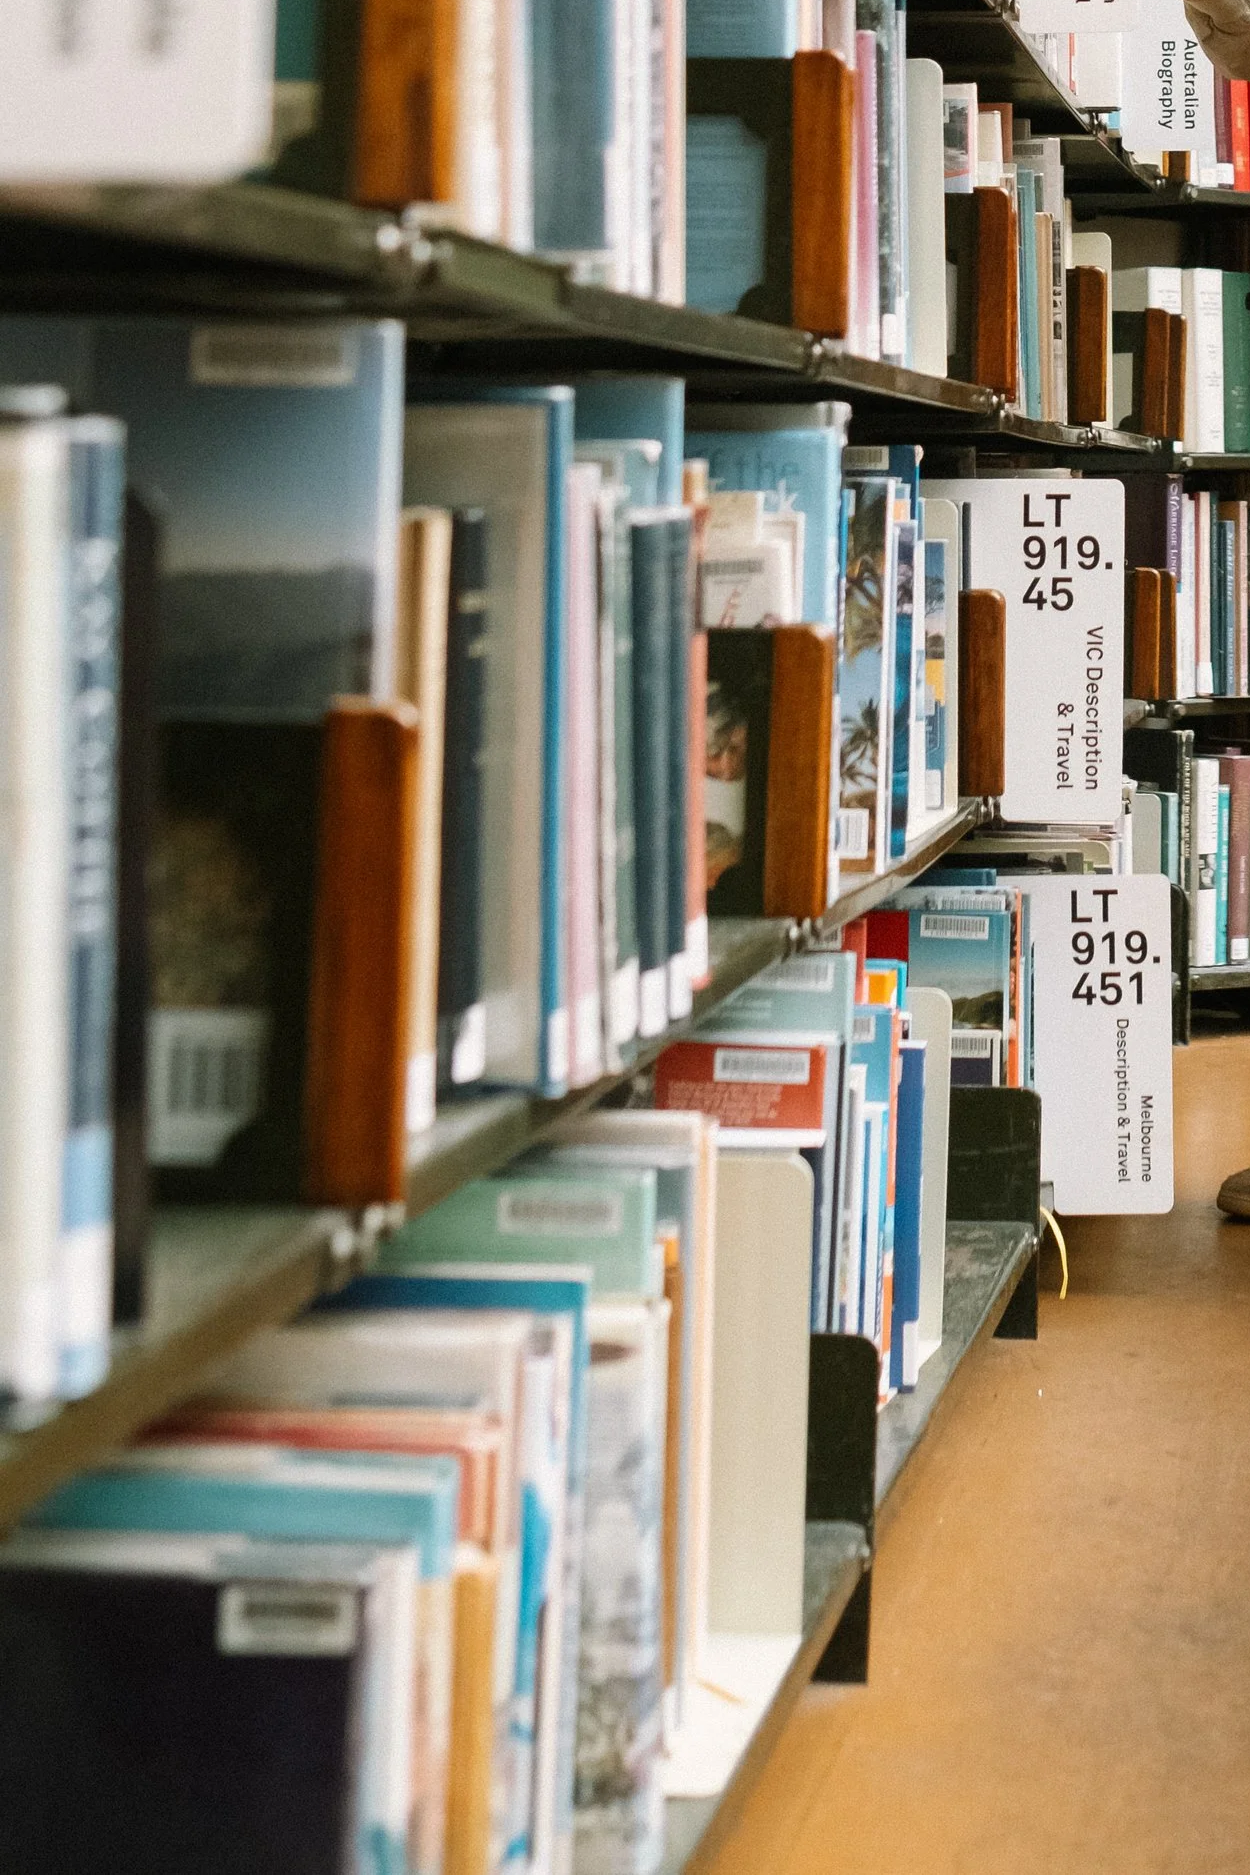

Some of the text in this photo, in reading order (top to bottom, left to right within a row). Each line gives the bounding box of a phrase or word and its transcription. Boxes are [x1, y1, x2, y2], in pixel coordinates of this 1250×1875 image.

[1157, 41, 1176, 129] Biography
[1184, 39, 1199, 129] Australian
[1024, 494, 1071, 527] LT
[1023, 536, 1112, 570] 919.
[1023, 577, 1073, 611] 45
[1082, 626, 1103, 789] VIC Description
[1057, 703, 1074, 789] & Travel
[1071, 890, 1118, 923] LT
[1072, 931, 1160, 965] 919.
[1072, 972, 1142, 1005] 451
[1115, 1019, 1130, 1183] Description & Travel
[1141, 1096, 1153, 1182] Melbourne
